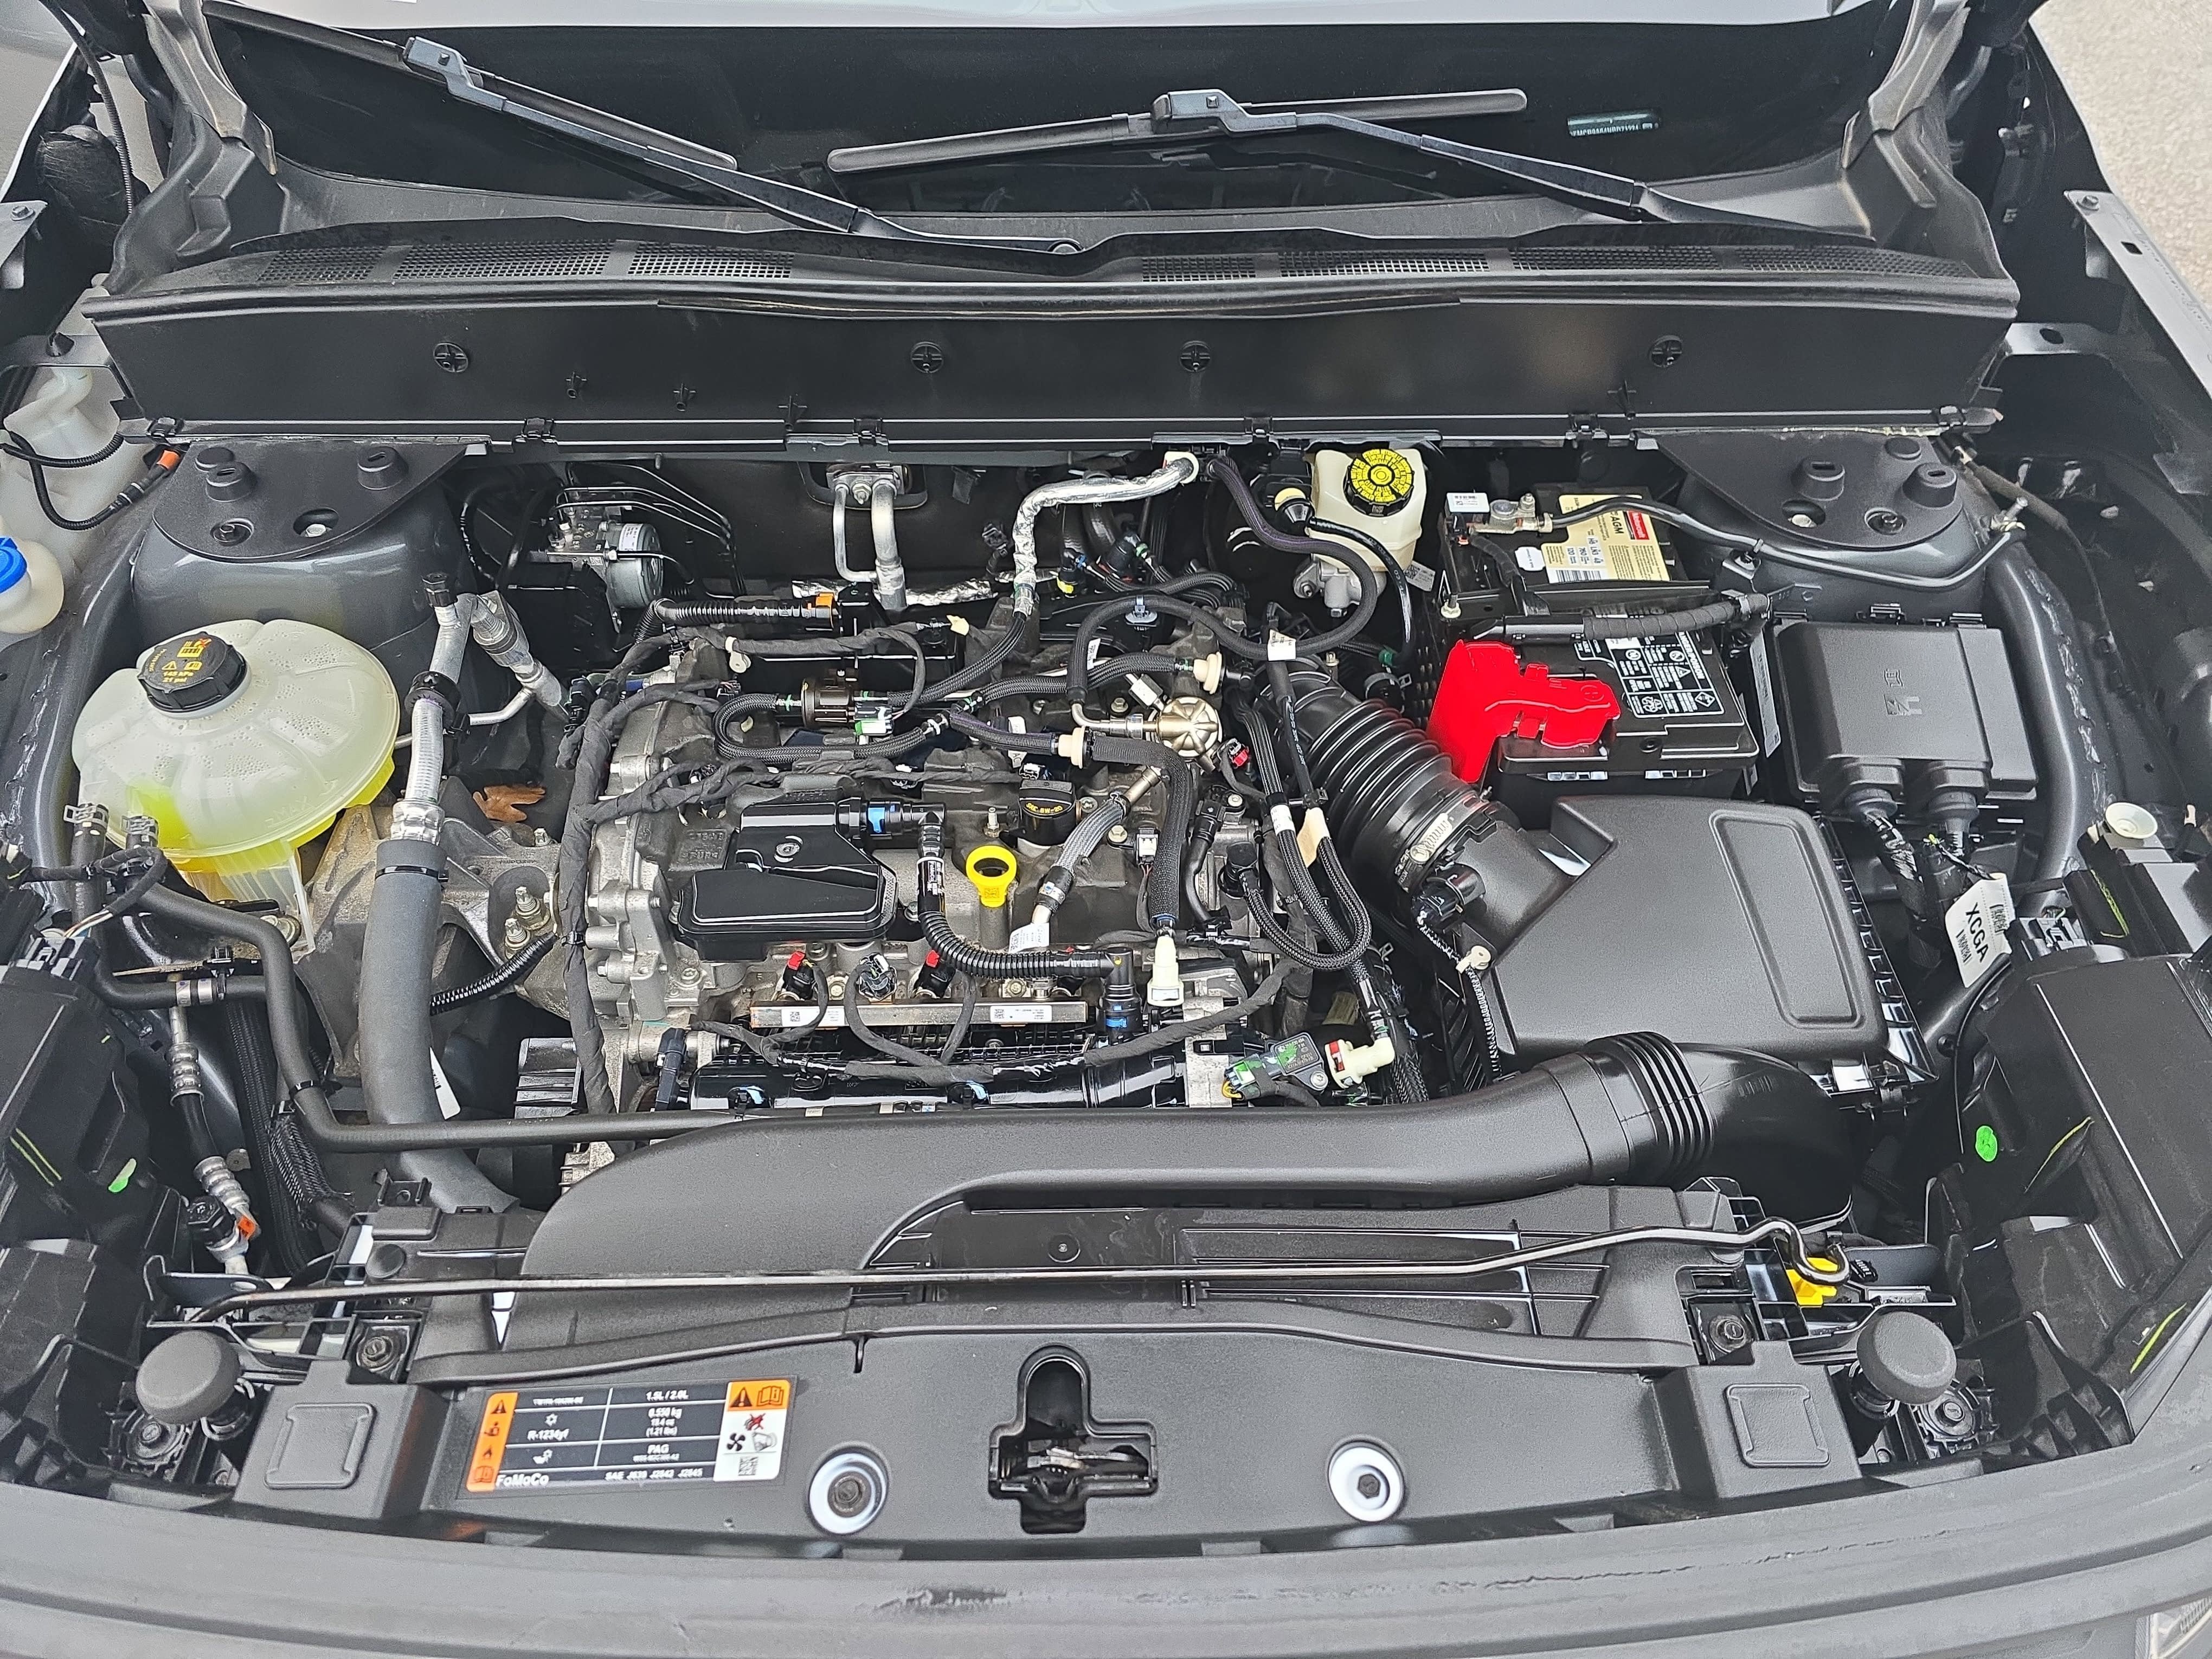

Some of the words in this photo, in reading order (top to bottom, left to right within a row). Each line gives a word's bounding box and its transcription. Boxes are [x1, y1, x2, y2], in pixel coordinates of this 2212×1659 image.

[1610, 516, 1624, 534] AGM
[1026, 802, 1038, 812] SAE
[1966, 902, 1989, 963] XCGA
[670, 1390, 689, 1400] 2.0L
[647, 1444, 669, 1455] PAG
[496, 1472, 549, 1488] FoMoCo
